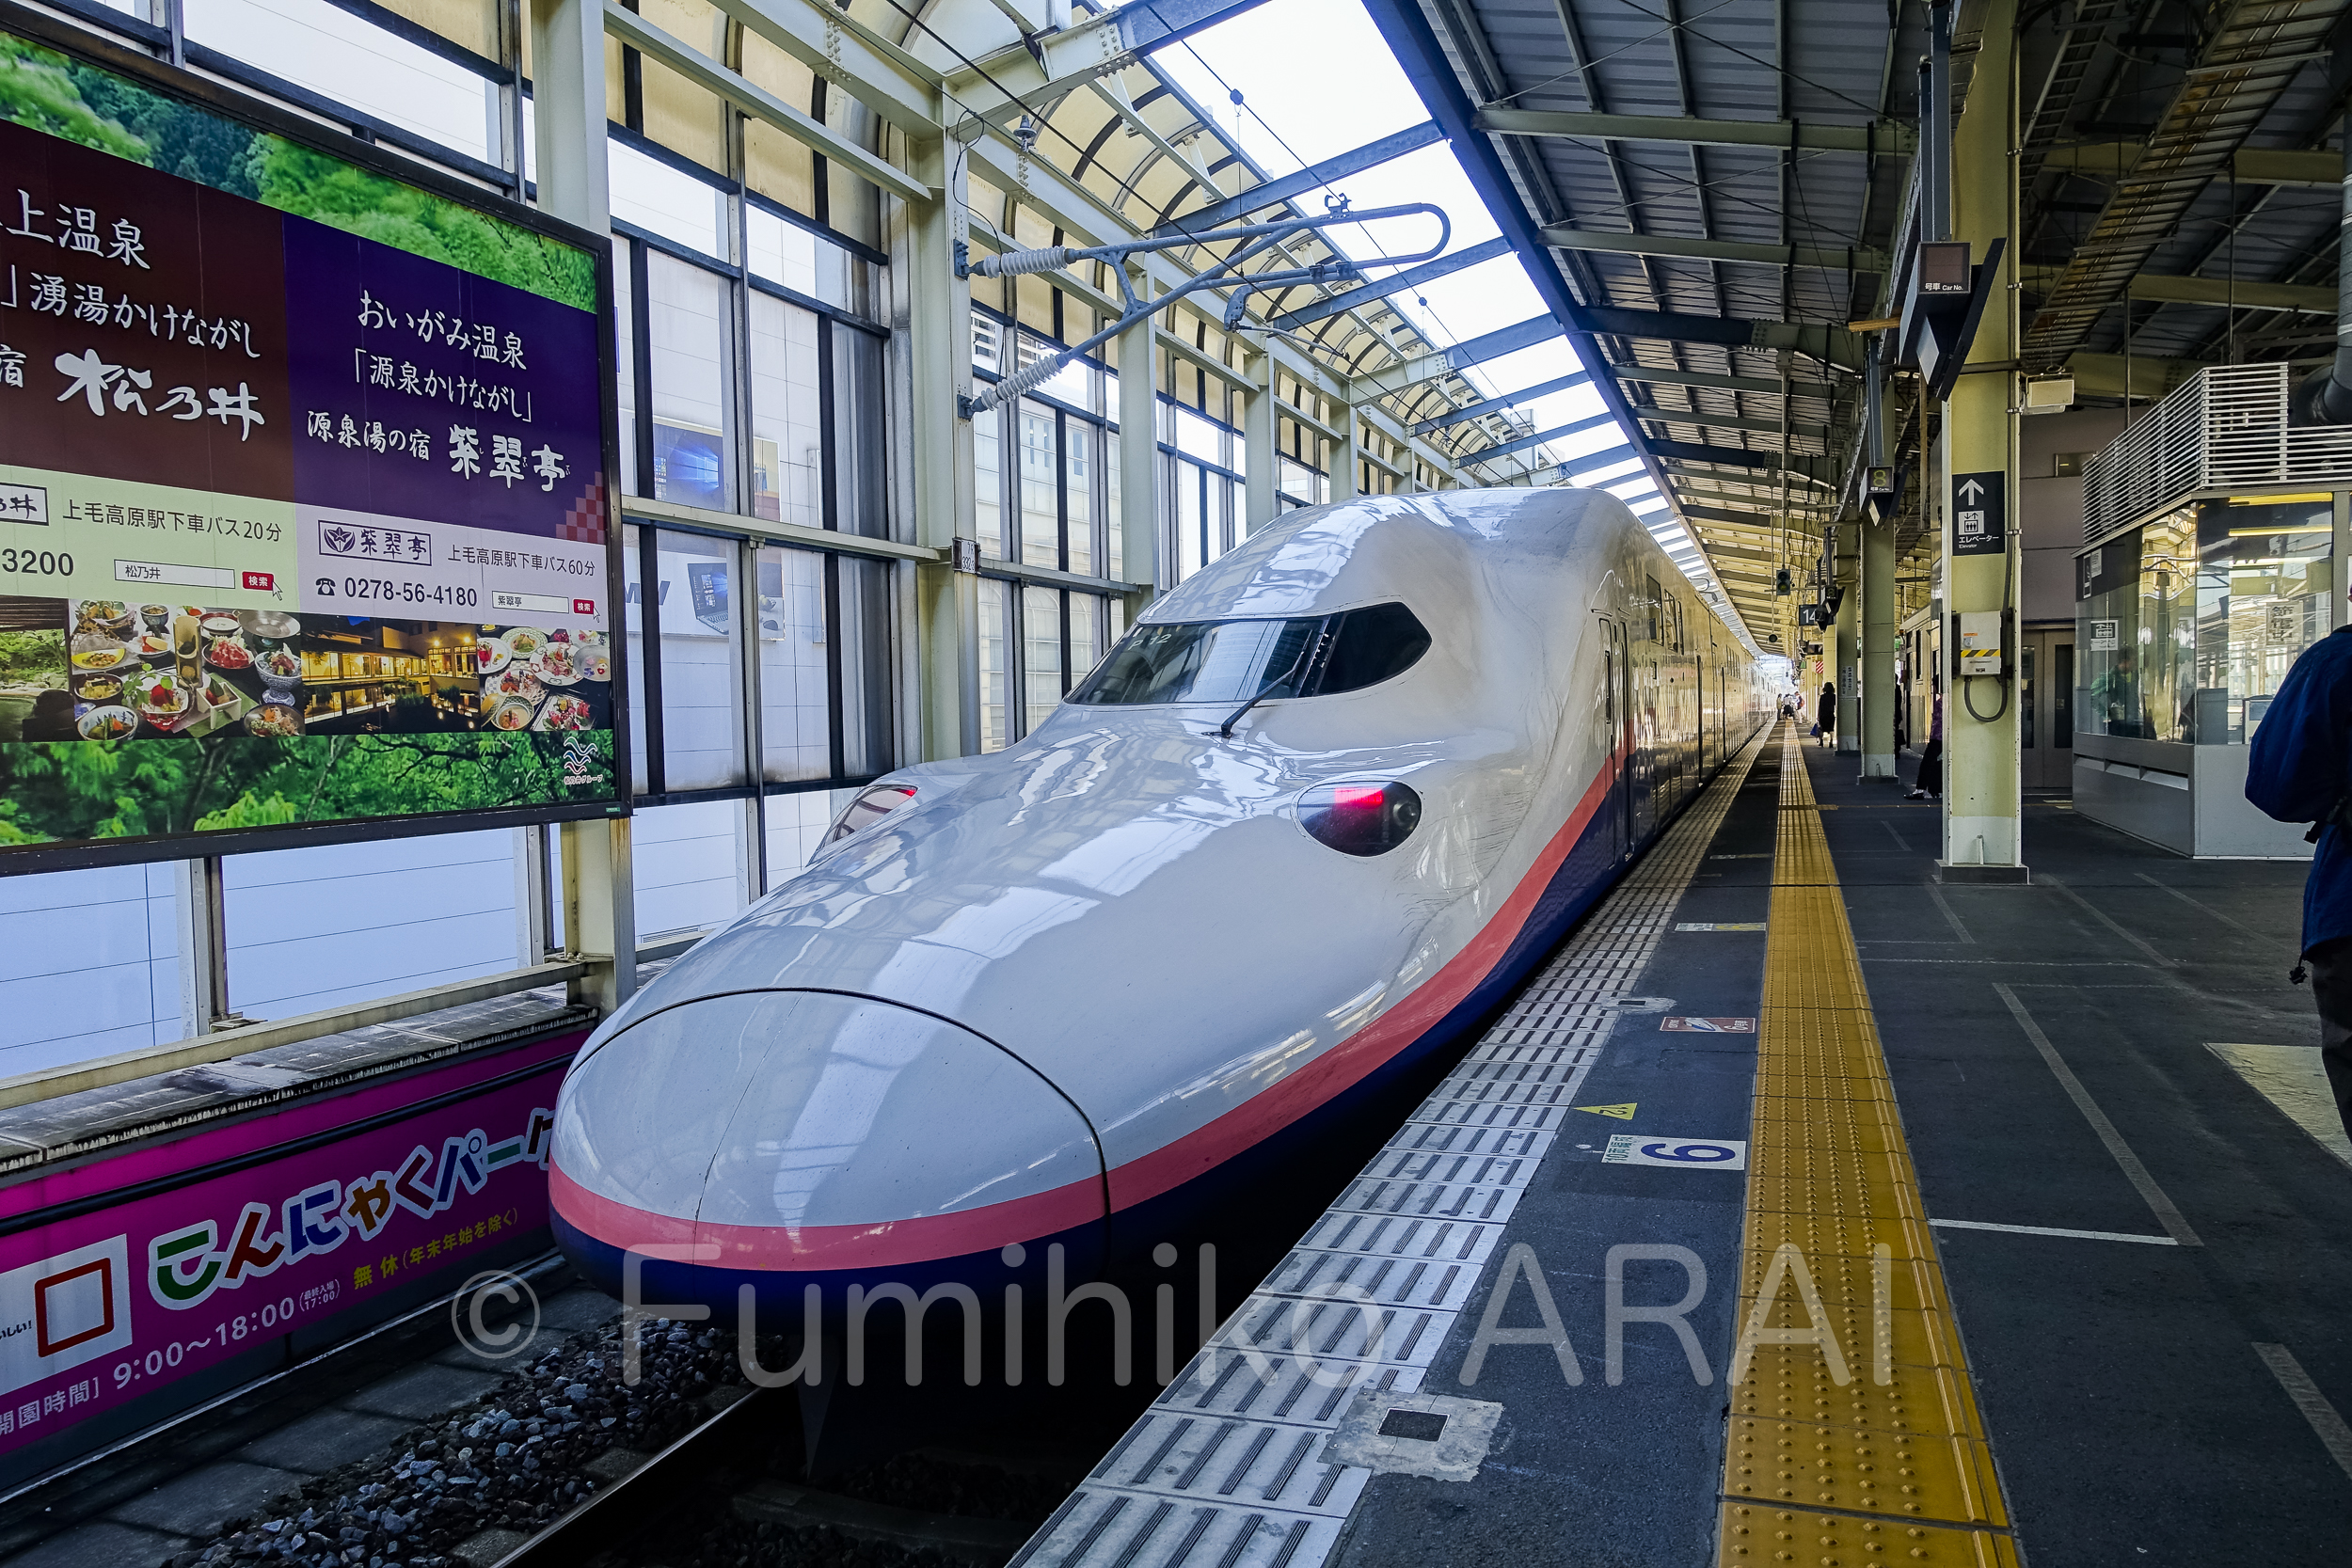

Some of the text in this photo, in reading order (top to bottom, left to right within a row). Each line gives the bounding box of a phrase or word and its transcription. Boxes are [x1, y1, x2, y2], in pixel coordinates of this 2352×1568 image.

[0, 188, 151, 270] 上温泉
[1925, 282, 1941, 291] 号車
[358, 289, 527, 371] おいがみ温泉
[55, 348, 265, 442] 松乃井
[355, 348, 532, 422] 「源泉かけながし」
[307, 411, 566, 492] 源泉湯の宿 紫翠亭
[1873, 469, 1886, 487] 8
[62, 499, 282, 543] 上毛高原駅下車バス20分
[360, 529, 427, 562] 紫翠亭
[1959, 534, 1999, 544] エレベーター
[1, 547, 74, 577] 3200
[447, 544, 596, 577] 上毛高原駅下車バス60分
[124, 564, 161, 580] 松乃井
[248, 575, 268, 587] 検索
[344, 577, 478, 608] 0278-56-4180
[497, 594, 523, 607] 紫翠亭
[577, 602, 592, 611] 検索
[1127, 633, 1172, 650] P 12
[1599, 1106, 1629, 1117] 12
[1640, 1143, 1737, 1163] 6
[304, 1290, 337, 1311] 17:00
